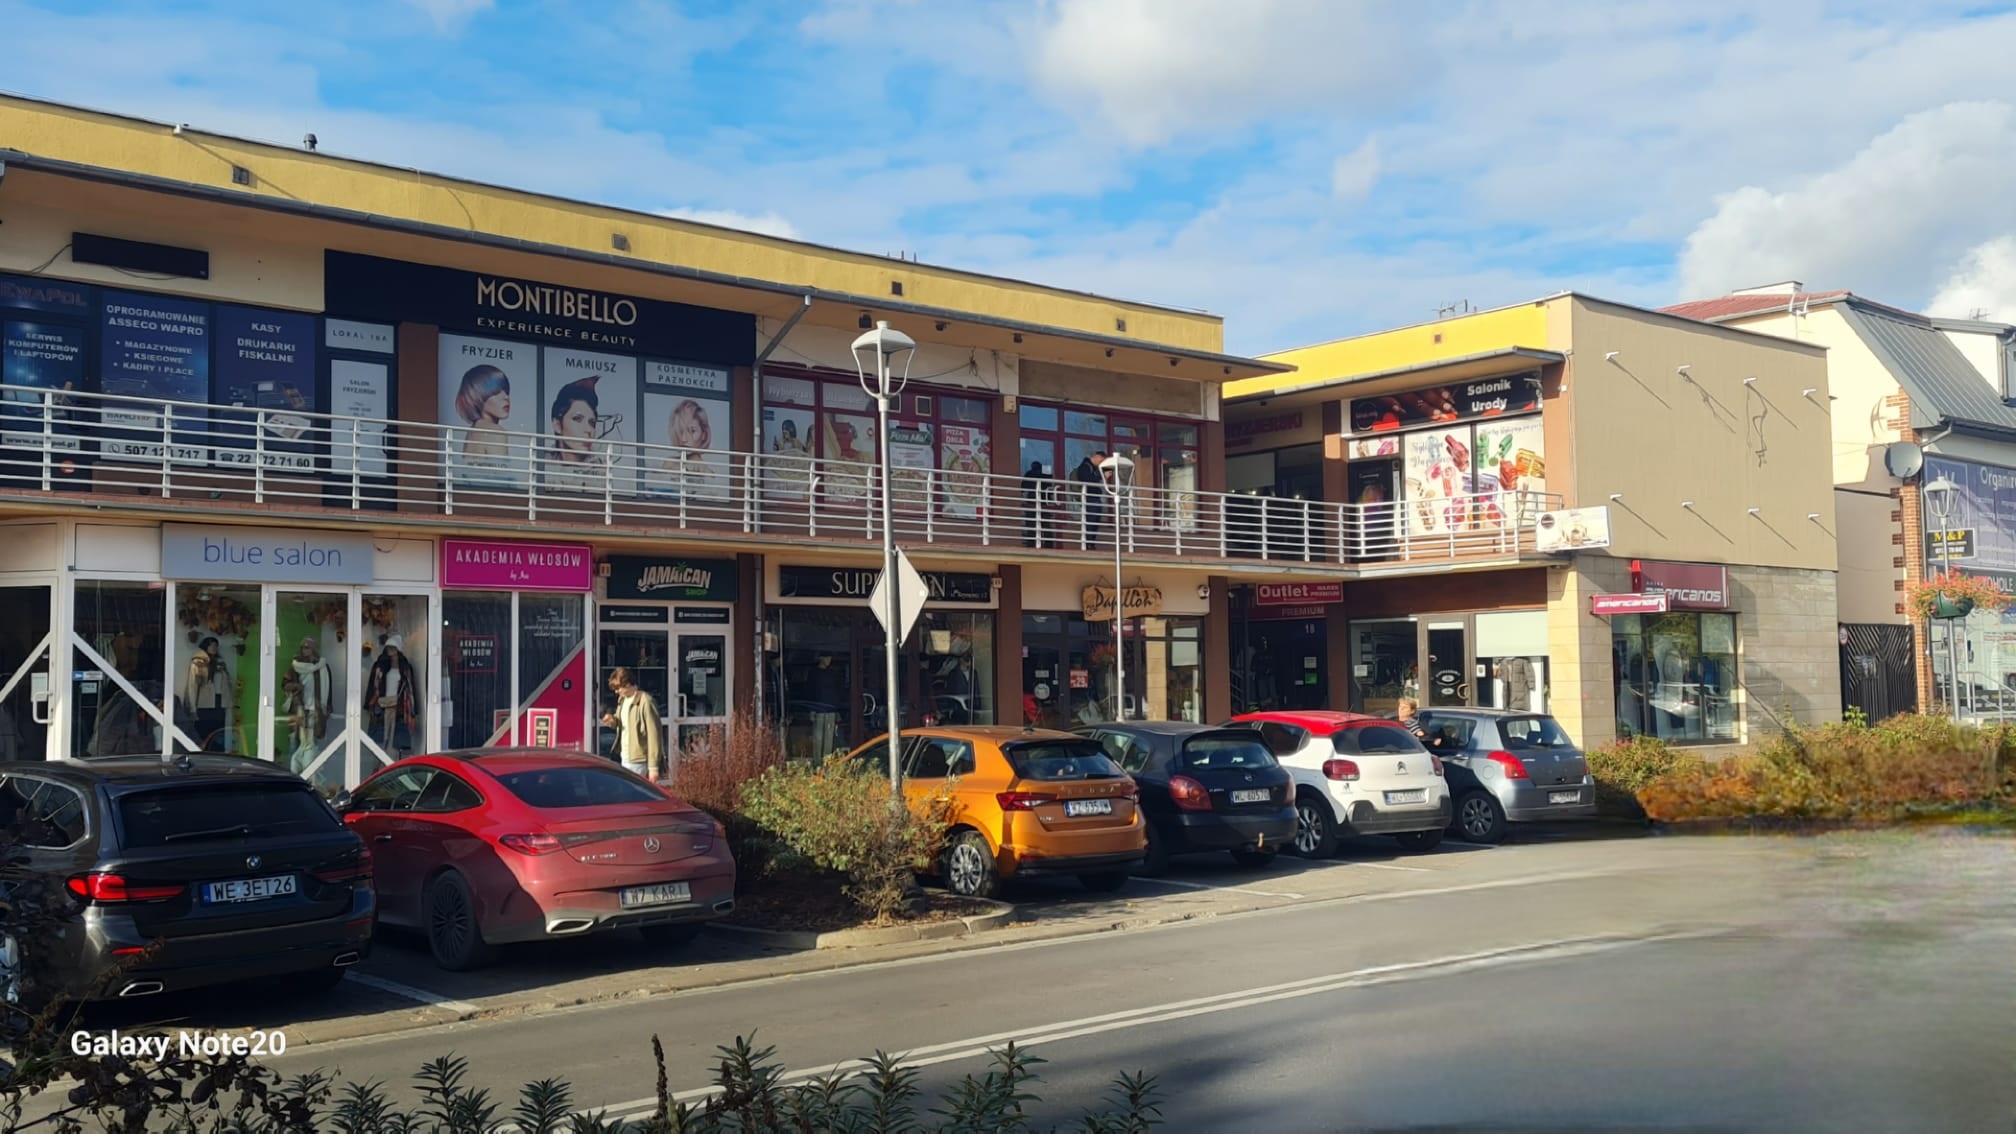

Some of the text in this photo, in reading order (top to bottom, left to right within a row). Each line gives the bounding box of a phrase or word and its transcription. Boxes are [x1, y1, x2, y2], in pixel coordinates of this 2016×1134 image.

[477, 277, 637, 325] MONTIBELLO
[106, 305, 206, 325] OPROGRAMOWANIE
[108, 317, 204, 335] ASSECO WAPRO
[251, 322, 282, 333] KASY
[477, 317, 636, 346] EXPERIENCE BEAUTY
[26, 333, 63, 343] SERWIS
[237, 337, 296, 352] DRUKARKI
[8, 340, 79, 352] KOMPUTERÓW
[461, 345, 514, 360] FRYZJER
[20, 350, 74, 361] LAPTOPÓW
[239, 350, 295, 363] FISKALNE
[565, 357, 617, 373] MARIUSZ
[657, 365, 717, 379] KOSMETYKA
[658, 375, 716, 389] PAZNOKCIE
[1466, 379, 1511, 396] Salonik
[1472, 397, 1507, 412] Urody
[125, 445, 146, 456] 507
[203, 537, 342, 567] blue salon
[456, 549, 581, 567] AKADEMIA WŁOSÓW
[638, 566, 711, 589] JAMAICAN
[1260, 584, 1309, 597] Outlet
[1281, 606, 1325, 617] PREMIUM
[213, 876, 292, 900] WE 3ET26
